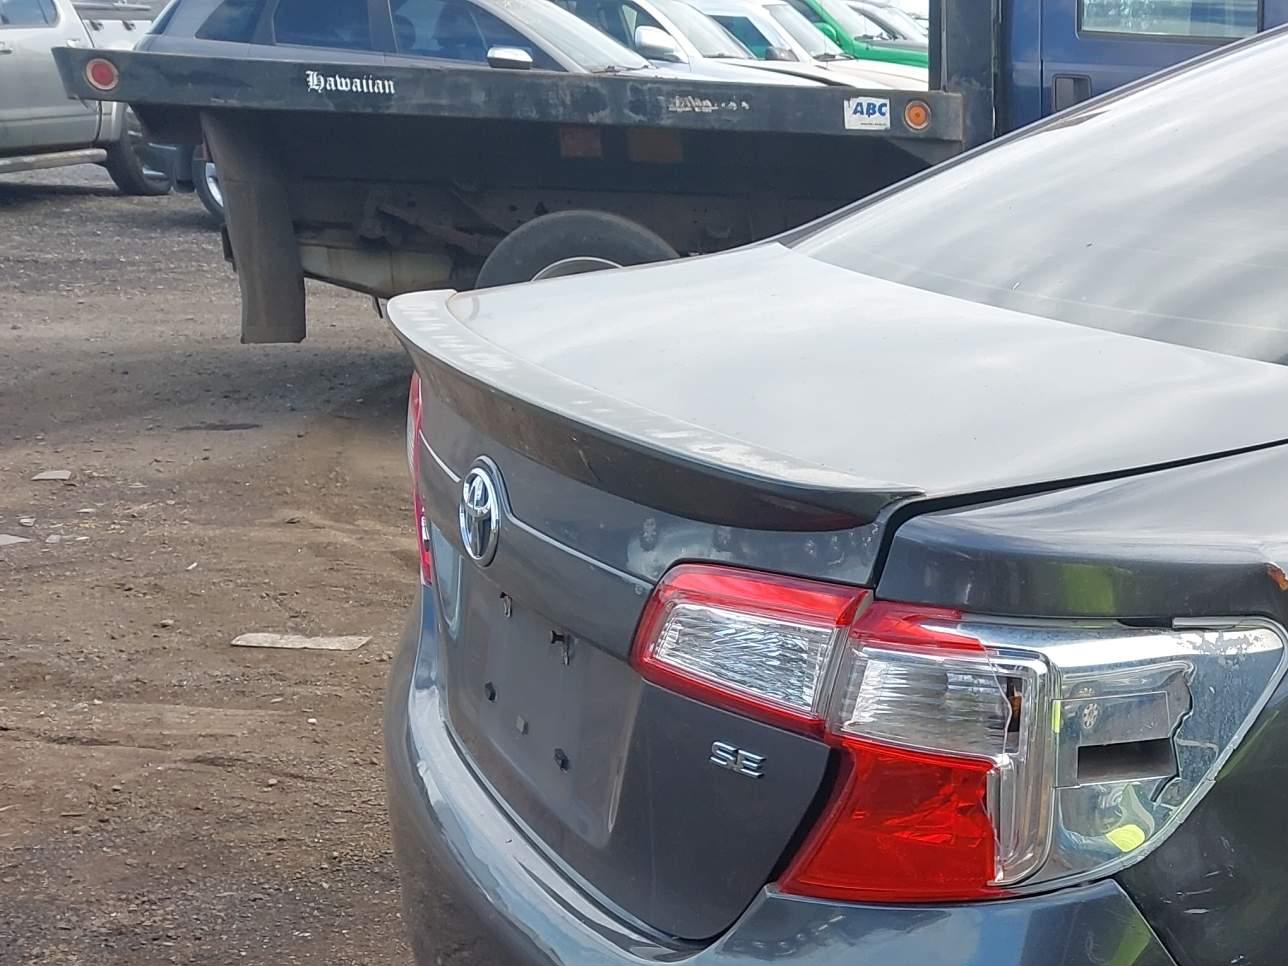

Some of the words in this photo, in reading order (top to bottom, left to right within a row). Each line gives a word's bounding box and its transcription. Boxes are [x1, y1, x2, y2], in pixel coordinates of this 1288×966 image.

[305, 70, 395, 94] Hawaiian
[853, 102, 888, 118] ABC
[710, 741, 766, 779] SE
